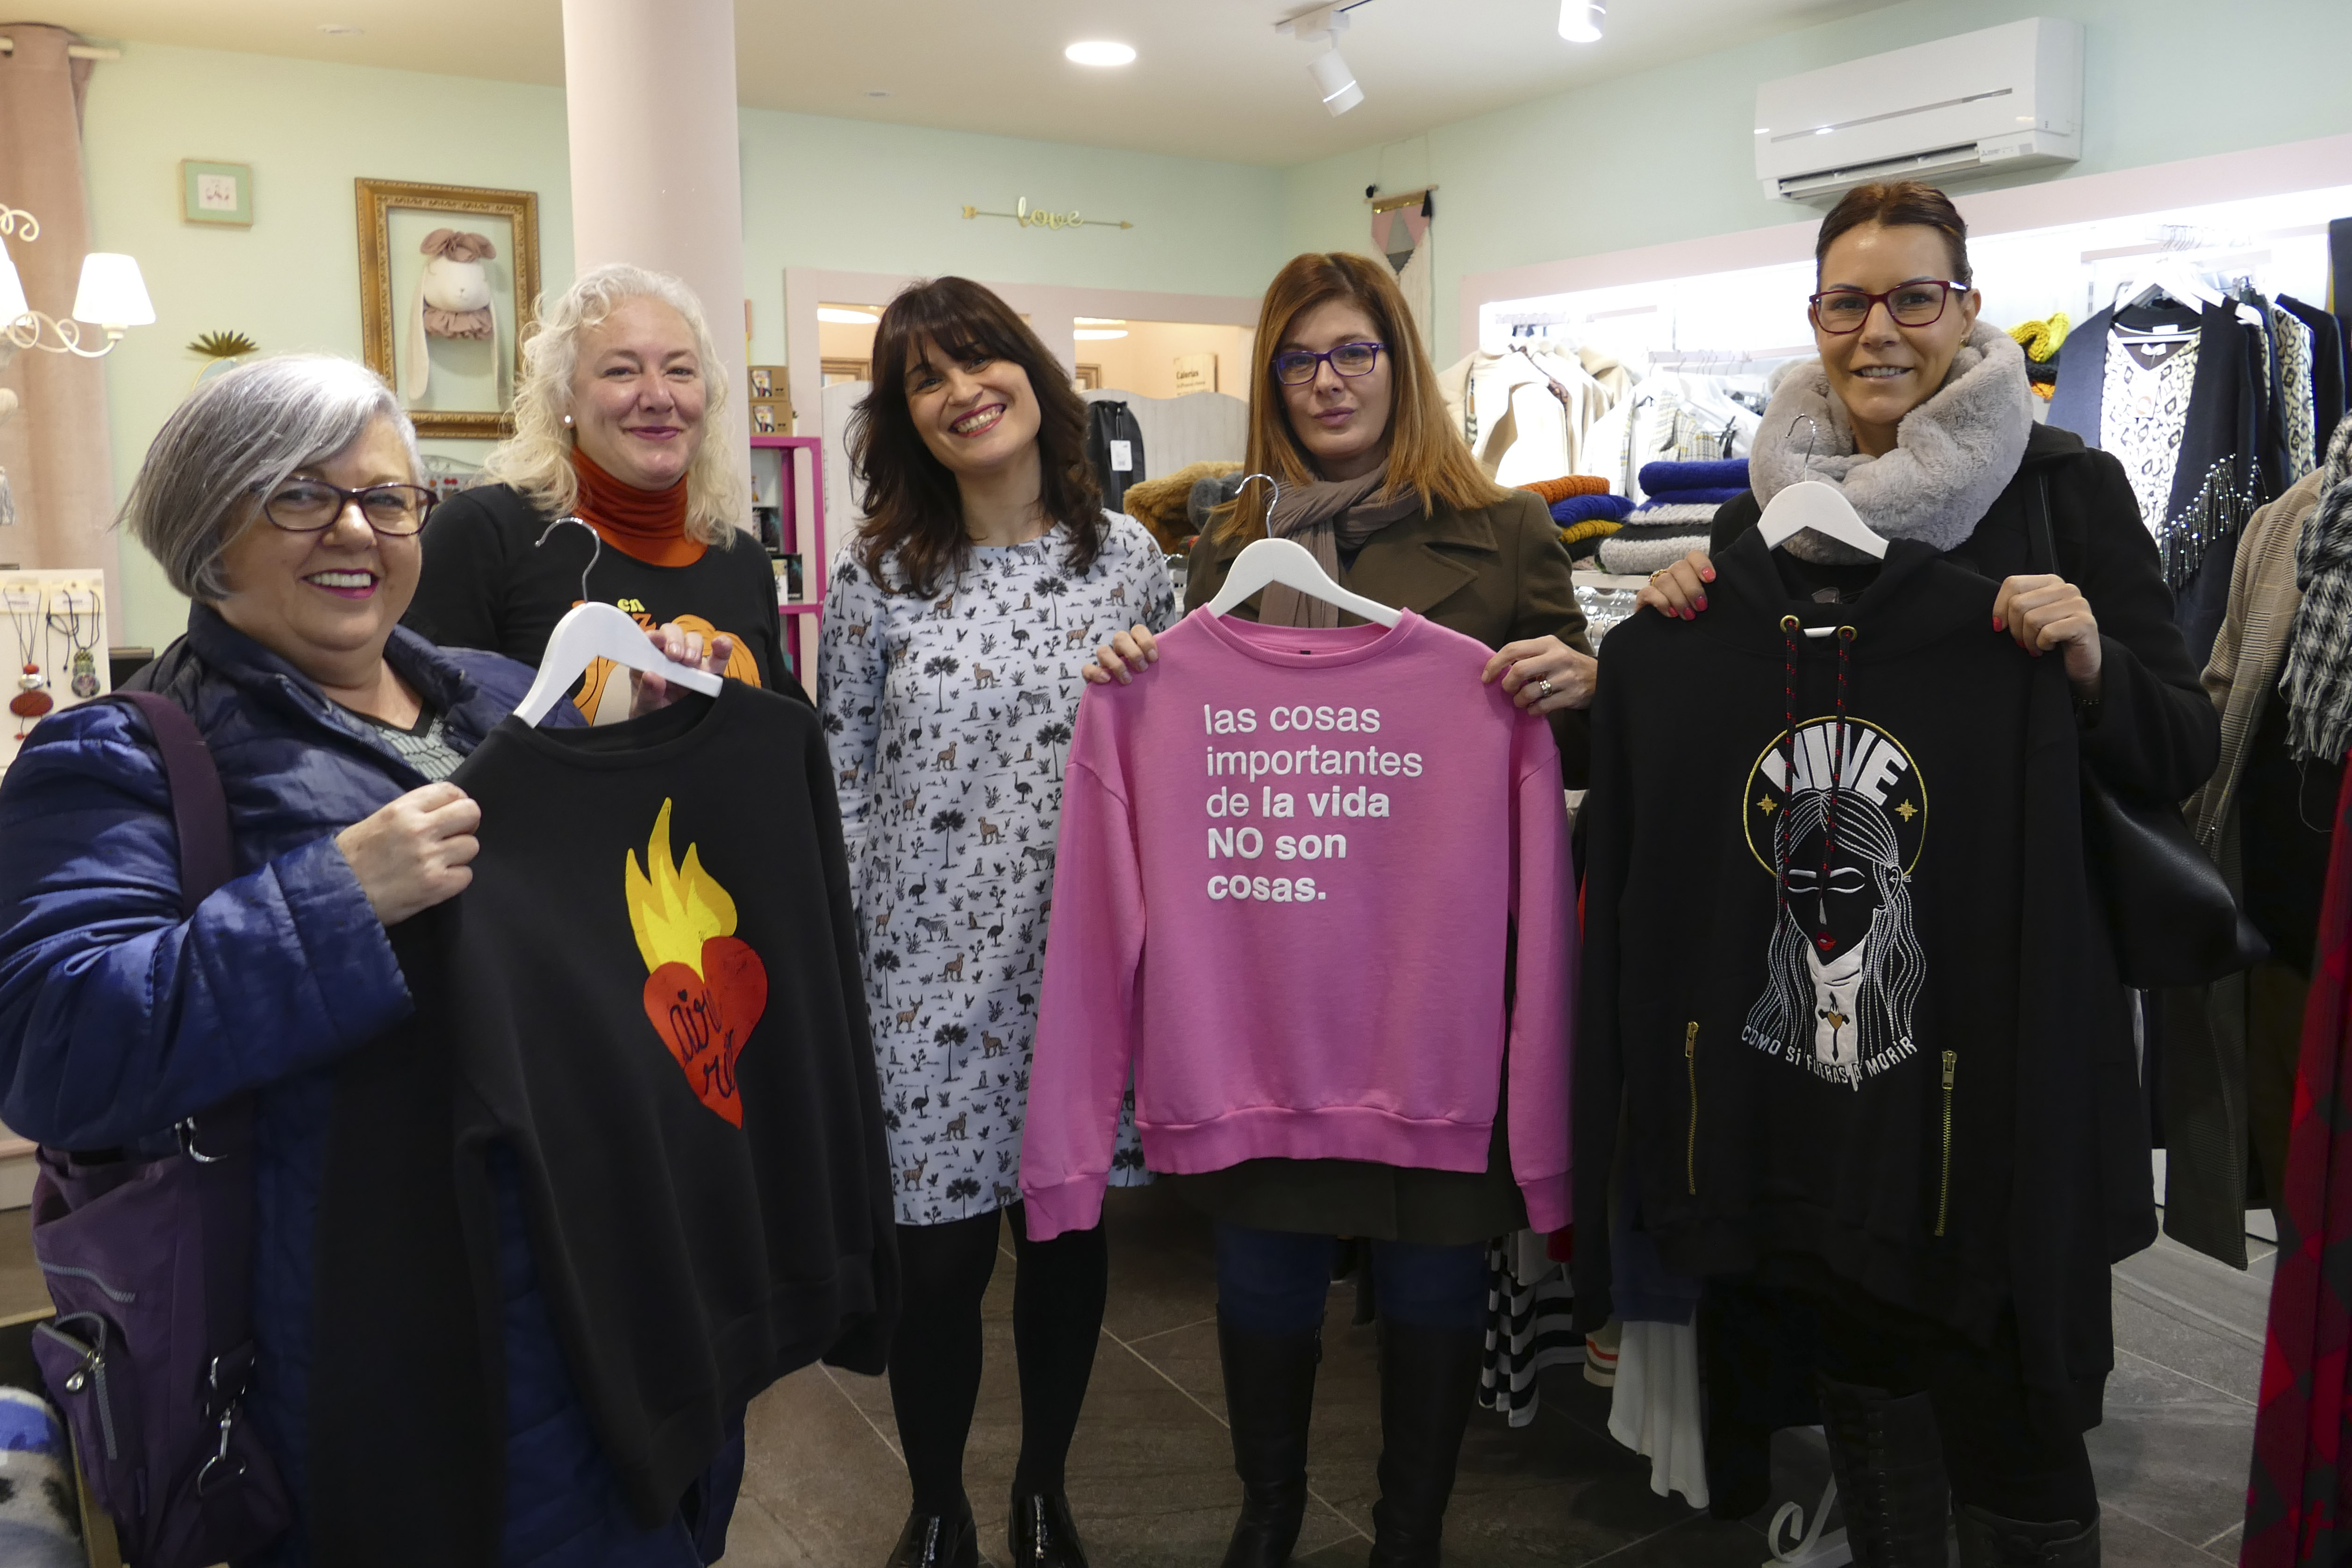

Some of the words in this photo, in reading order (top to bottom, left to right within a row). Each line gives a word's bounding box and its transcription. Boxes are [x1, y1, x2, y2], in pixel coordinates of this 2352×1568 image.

[1017, 196, 1084, 230] love
[617, 598, 645, 612] en
[1204, 704, 1257, 735] las
[1270, 705, 1380, 733] cosas
[1207, 745, 1423, 783] importantes
[1760, 722, 1909, 807] VIVE
[1206, 786, 1249, 818] de
[1262, 786, 1294, 818] la
[1307, 786, 1390, 818] vida
[1208, 827, 1263, 859] NO
[1275, 833, 1347, 860] son
[1207, 875, 1327, 902] cosas.
[1741, 1025, 1781, 1055] COMO
[1806, 1054, 1848, 1084] FUERAS
